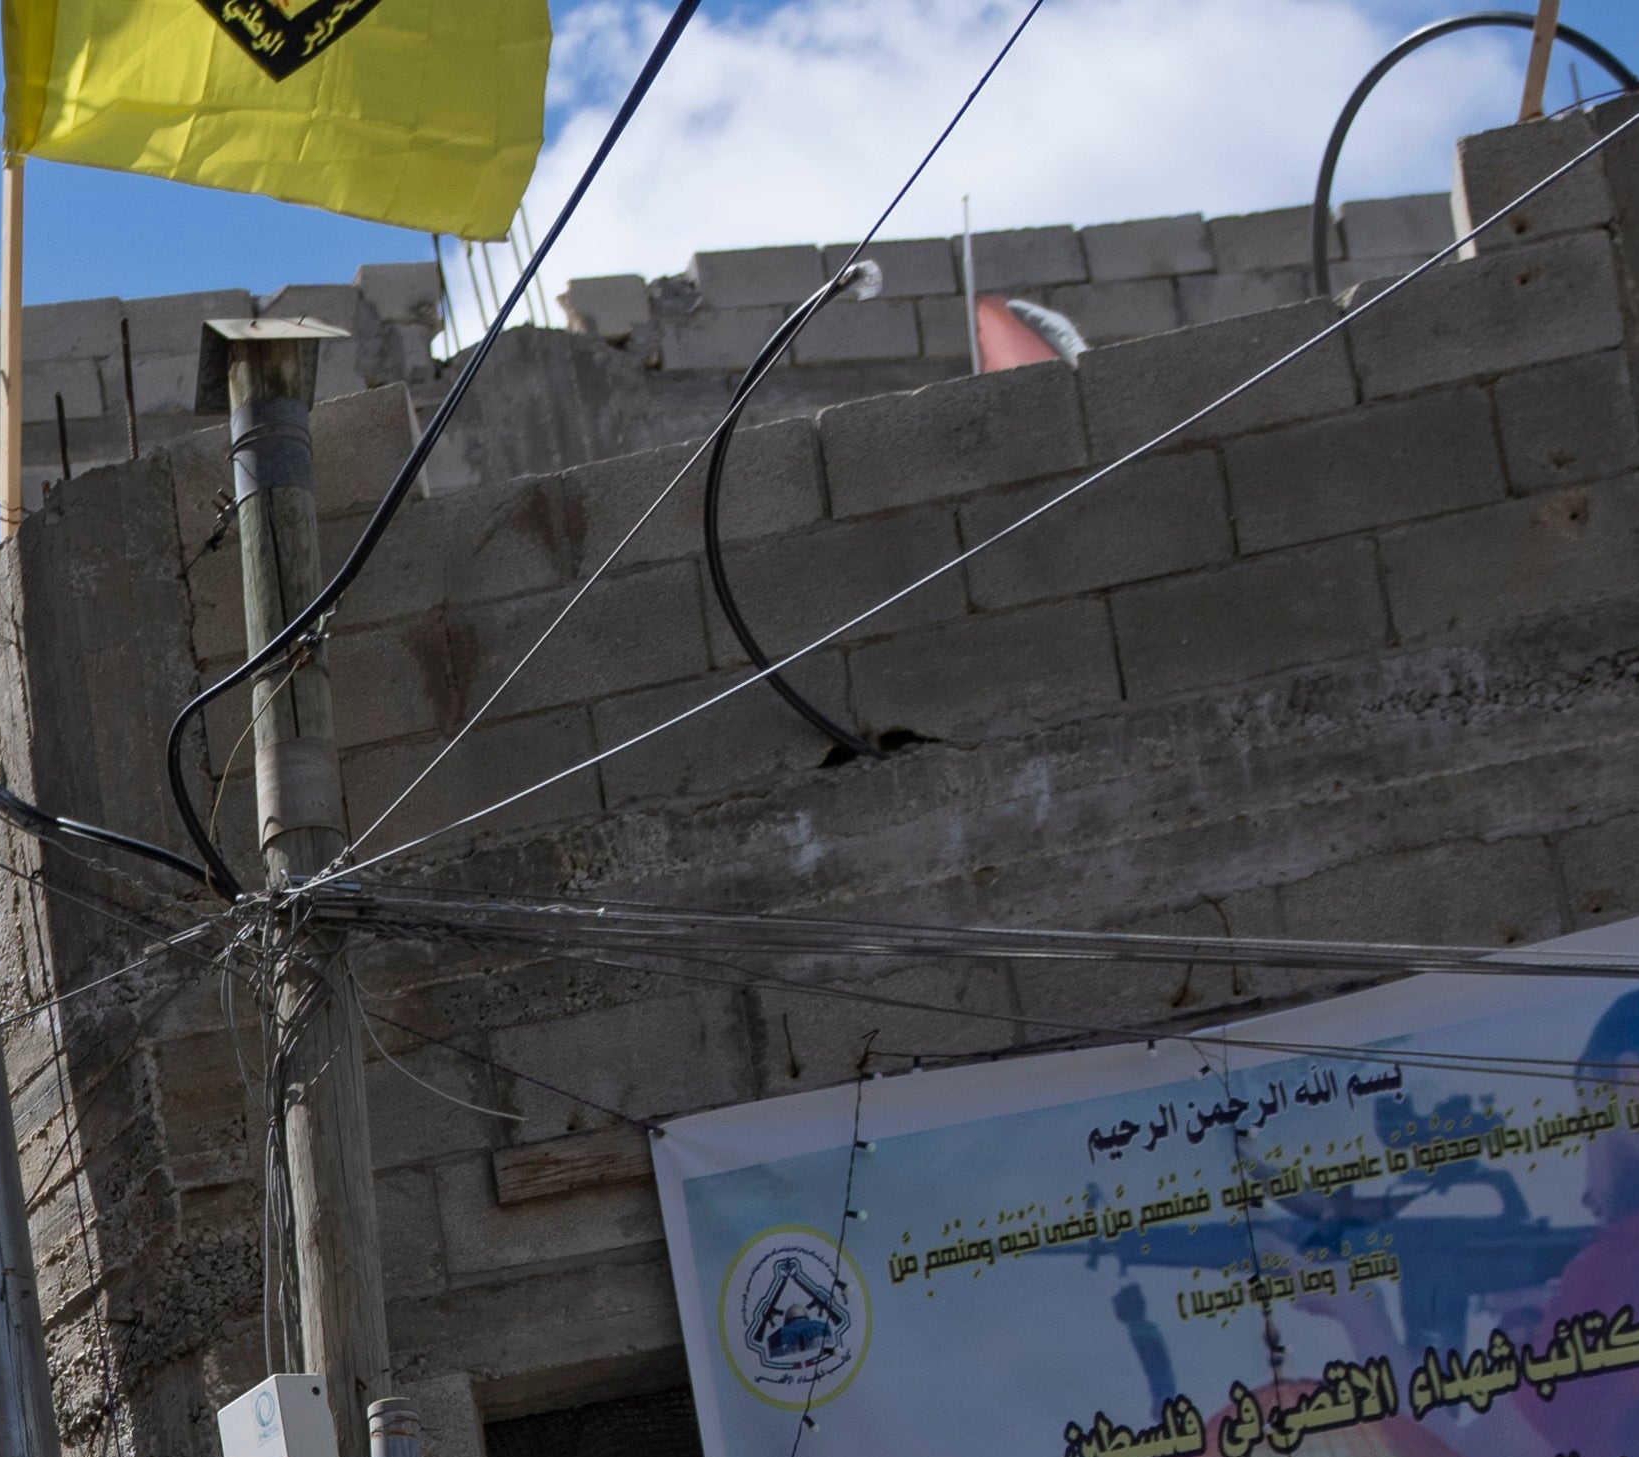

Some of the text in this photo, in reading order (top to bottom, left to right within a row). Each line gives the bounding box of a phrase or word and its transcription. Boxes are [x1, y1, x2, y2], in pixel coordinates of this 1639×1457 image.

[1088, 1064, 1403, 1165] بسم الله الرحمن الرحيم
[1267, 1358, 1397, 1453] الاقصى
[1412, 1329, 1521, 1413] شهداء
